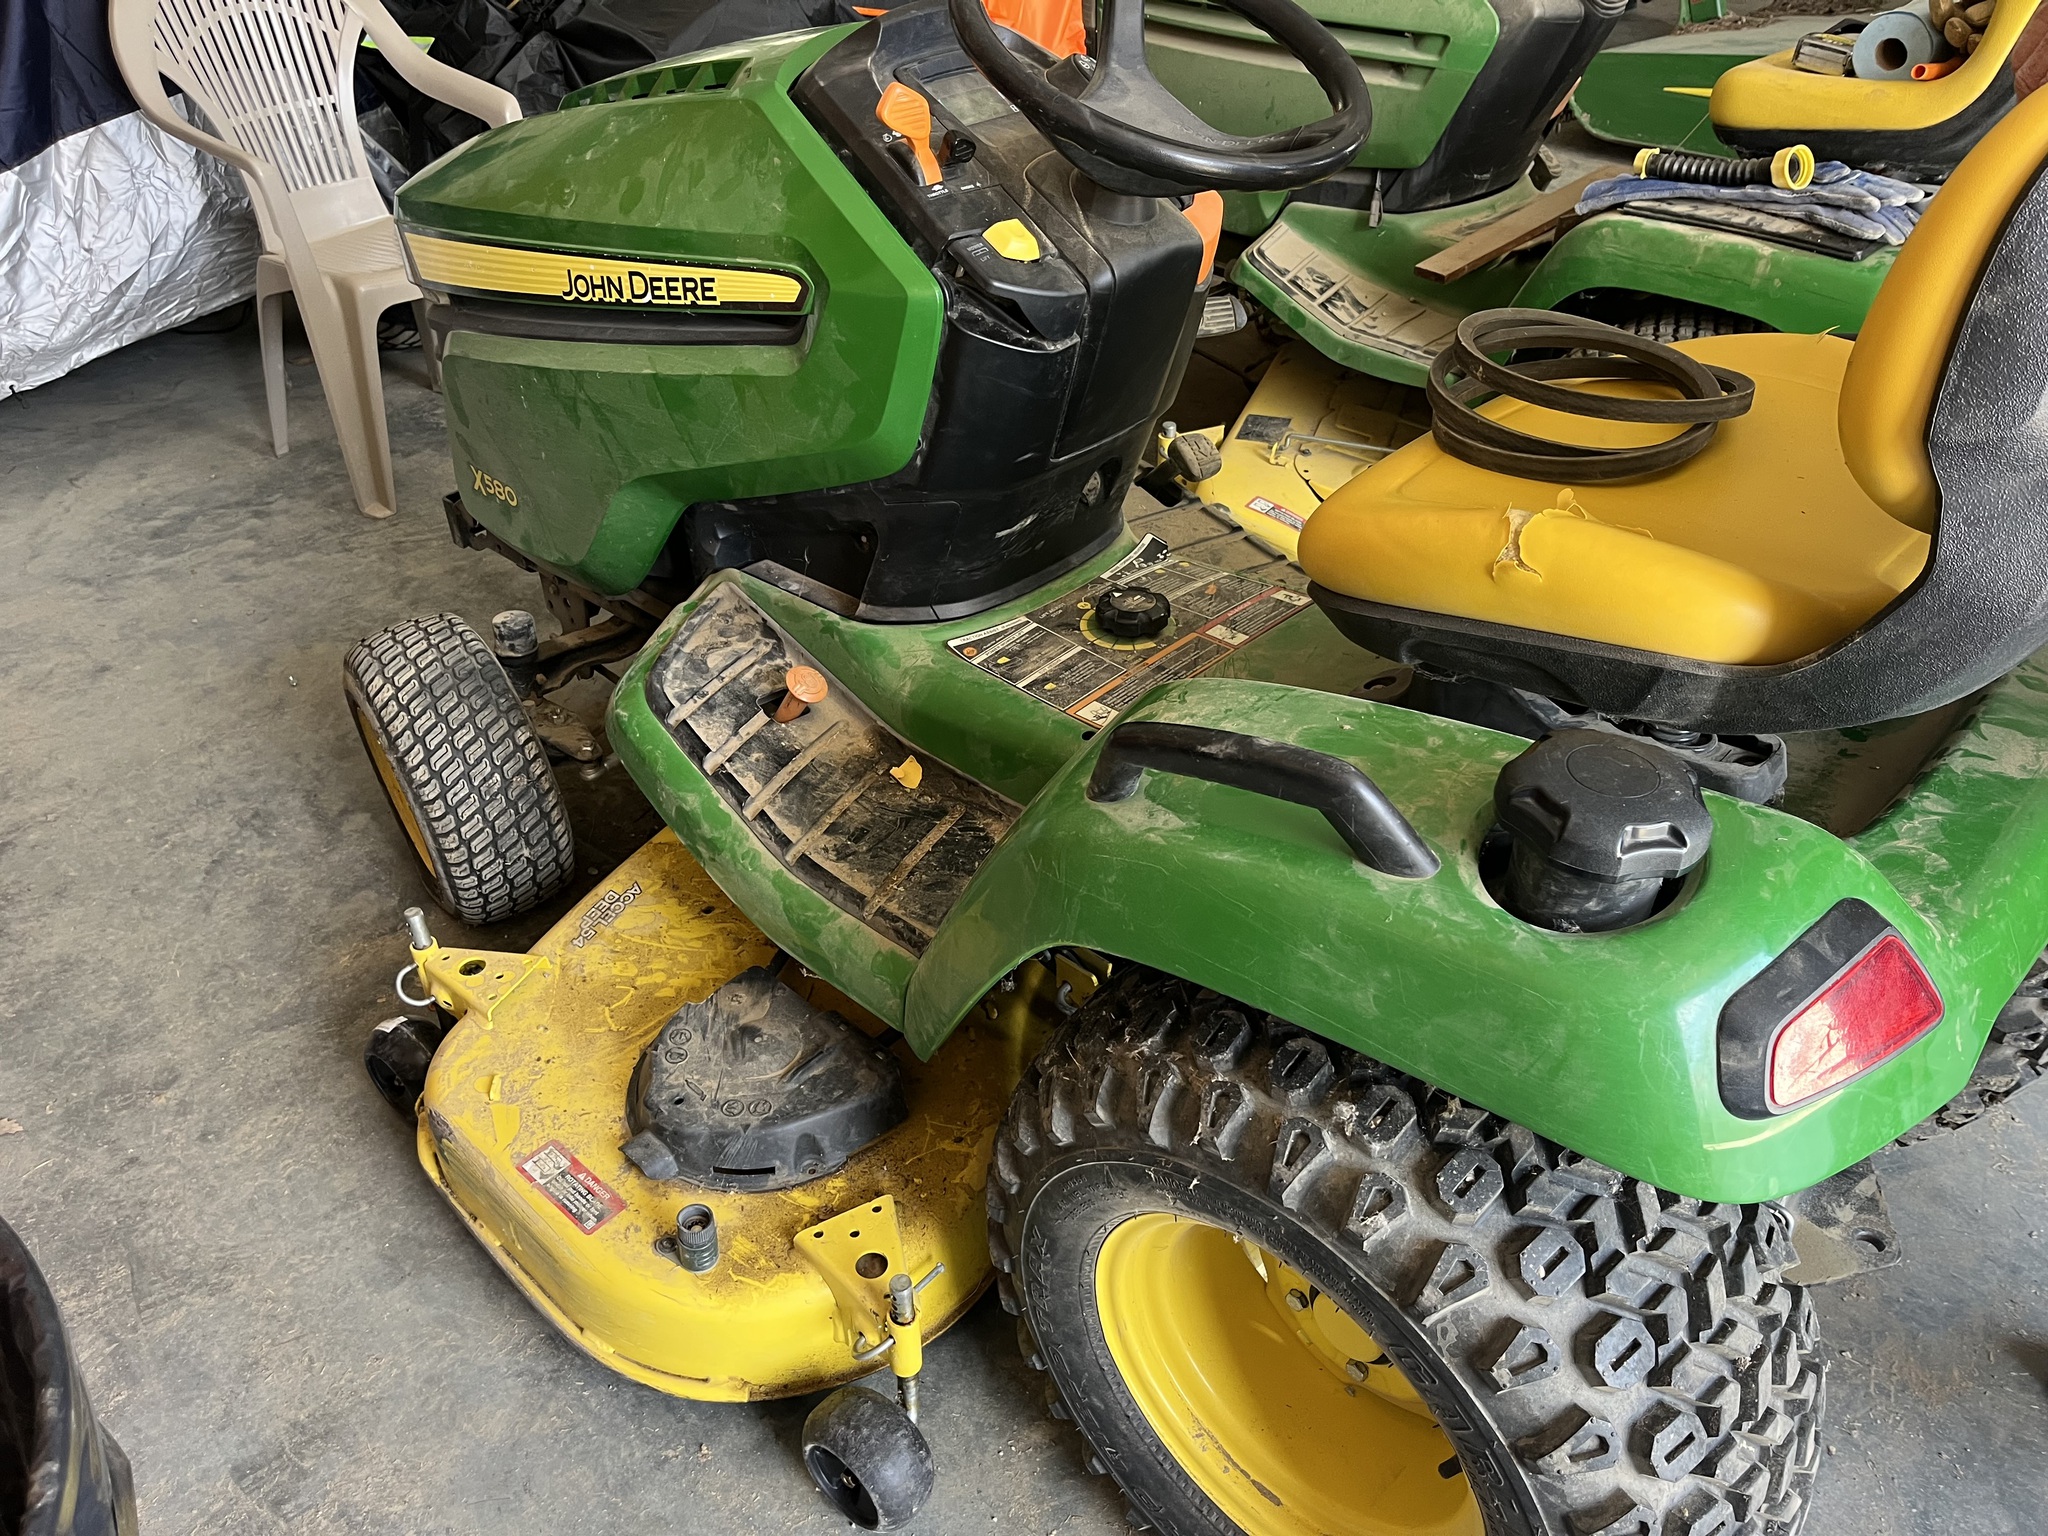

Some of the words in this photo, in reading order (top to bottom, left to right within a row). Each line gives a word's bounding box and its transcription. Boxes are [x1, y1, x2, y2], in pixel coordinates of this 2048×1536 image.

[562, 269, 624, 301] JOHN
[628, 271, 720, 304] DEERE
[470, 464, 518, 507] X580
[580, 890, 621, 930] DEEP
[592, 881, 643, 926] ACCEL
[571, 928, 597, 948] 54
[564, 1174, 588, 1195] ROTATING
[584, 1177, 611, 1200] DANGER
